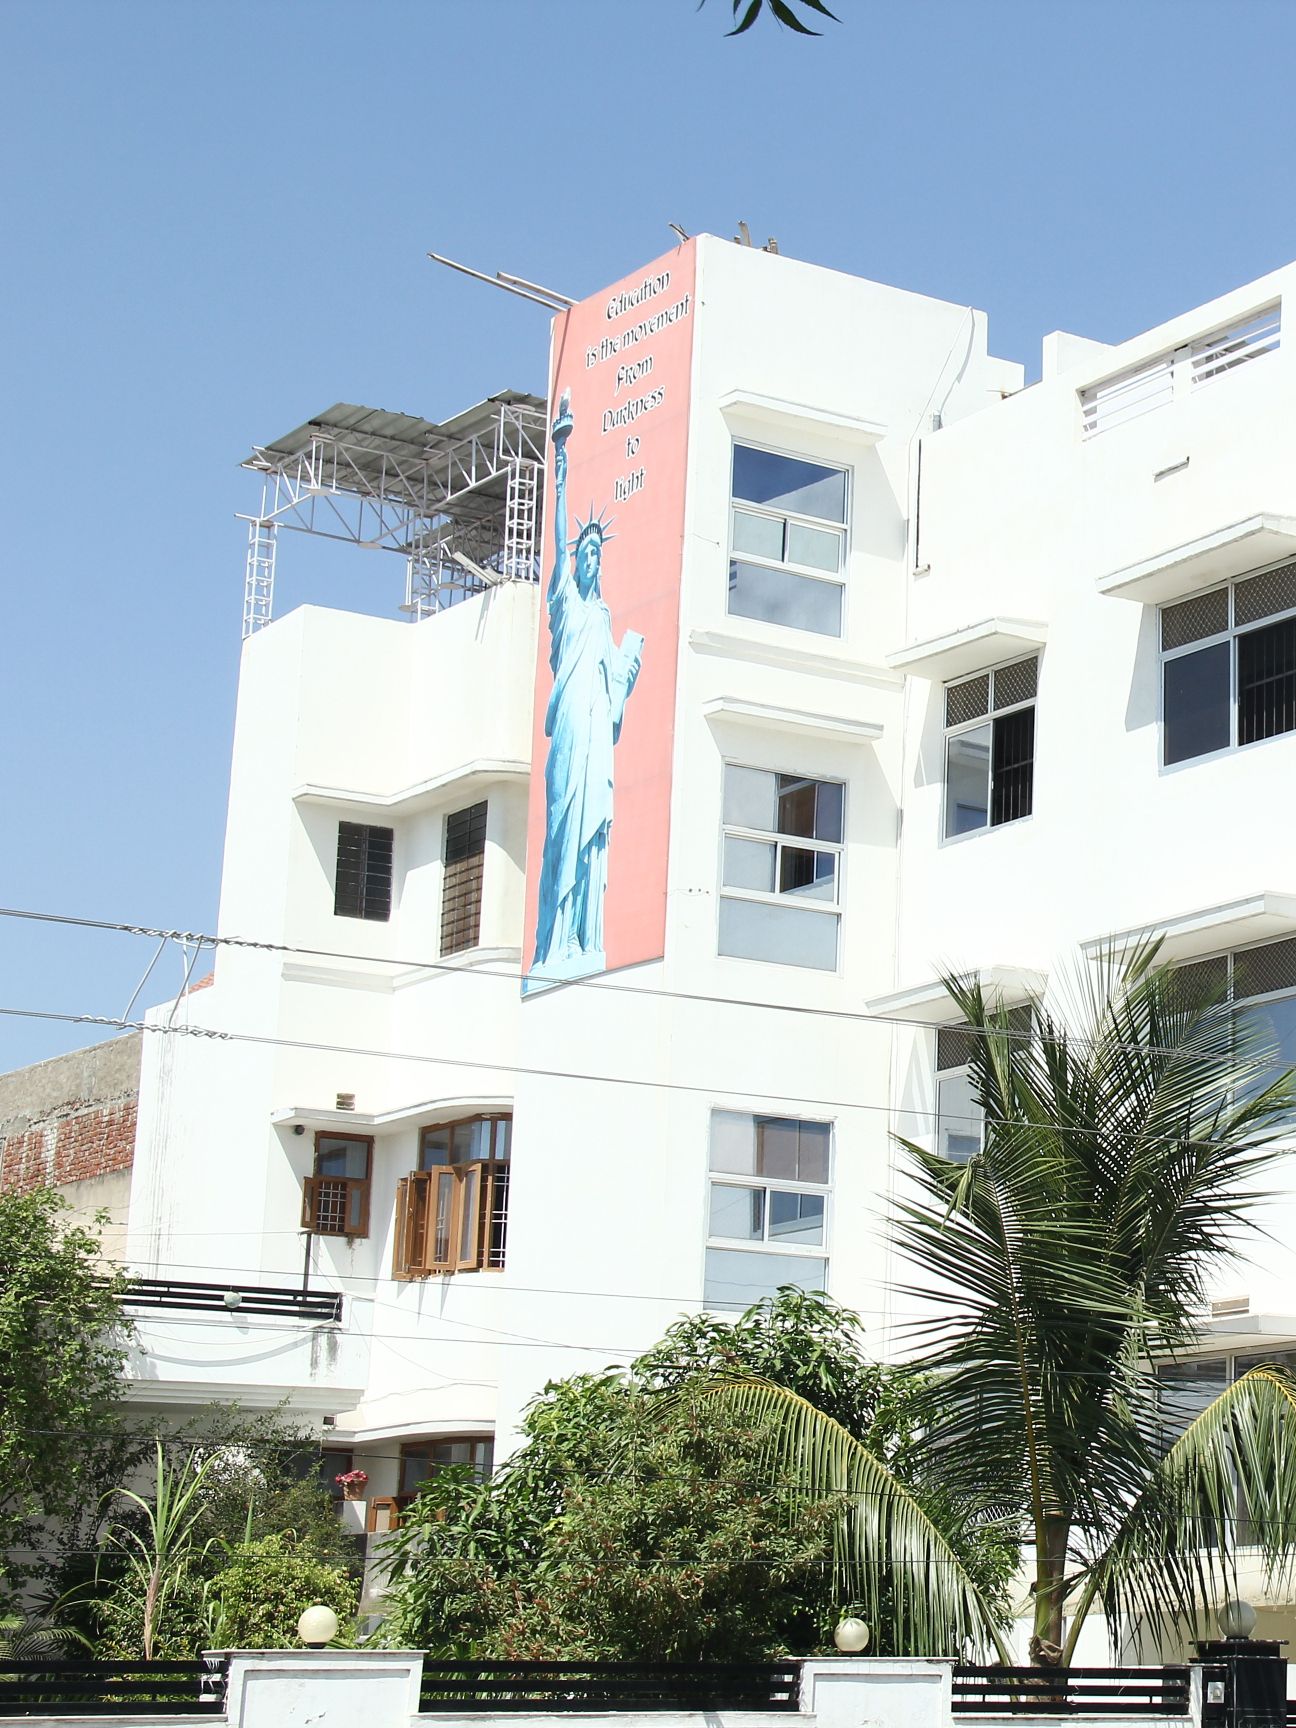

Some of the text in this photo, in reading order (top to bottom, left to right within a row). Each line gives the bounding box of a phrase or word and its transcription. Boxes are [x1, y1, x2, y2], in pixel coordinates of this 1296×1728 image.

[606, 271, 670, 320] Education
[586, 293, 690, 368] is the movement
[602, 386, 665, 433] Darkness
[626, 437, 640, 458] to
[614, 467, 645, 501] light
